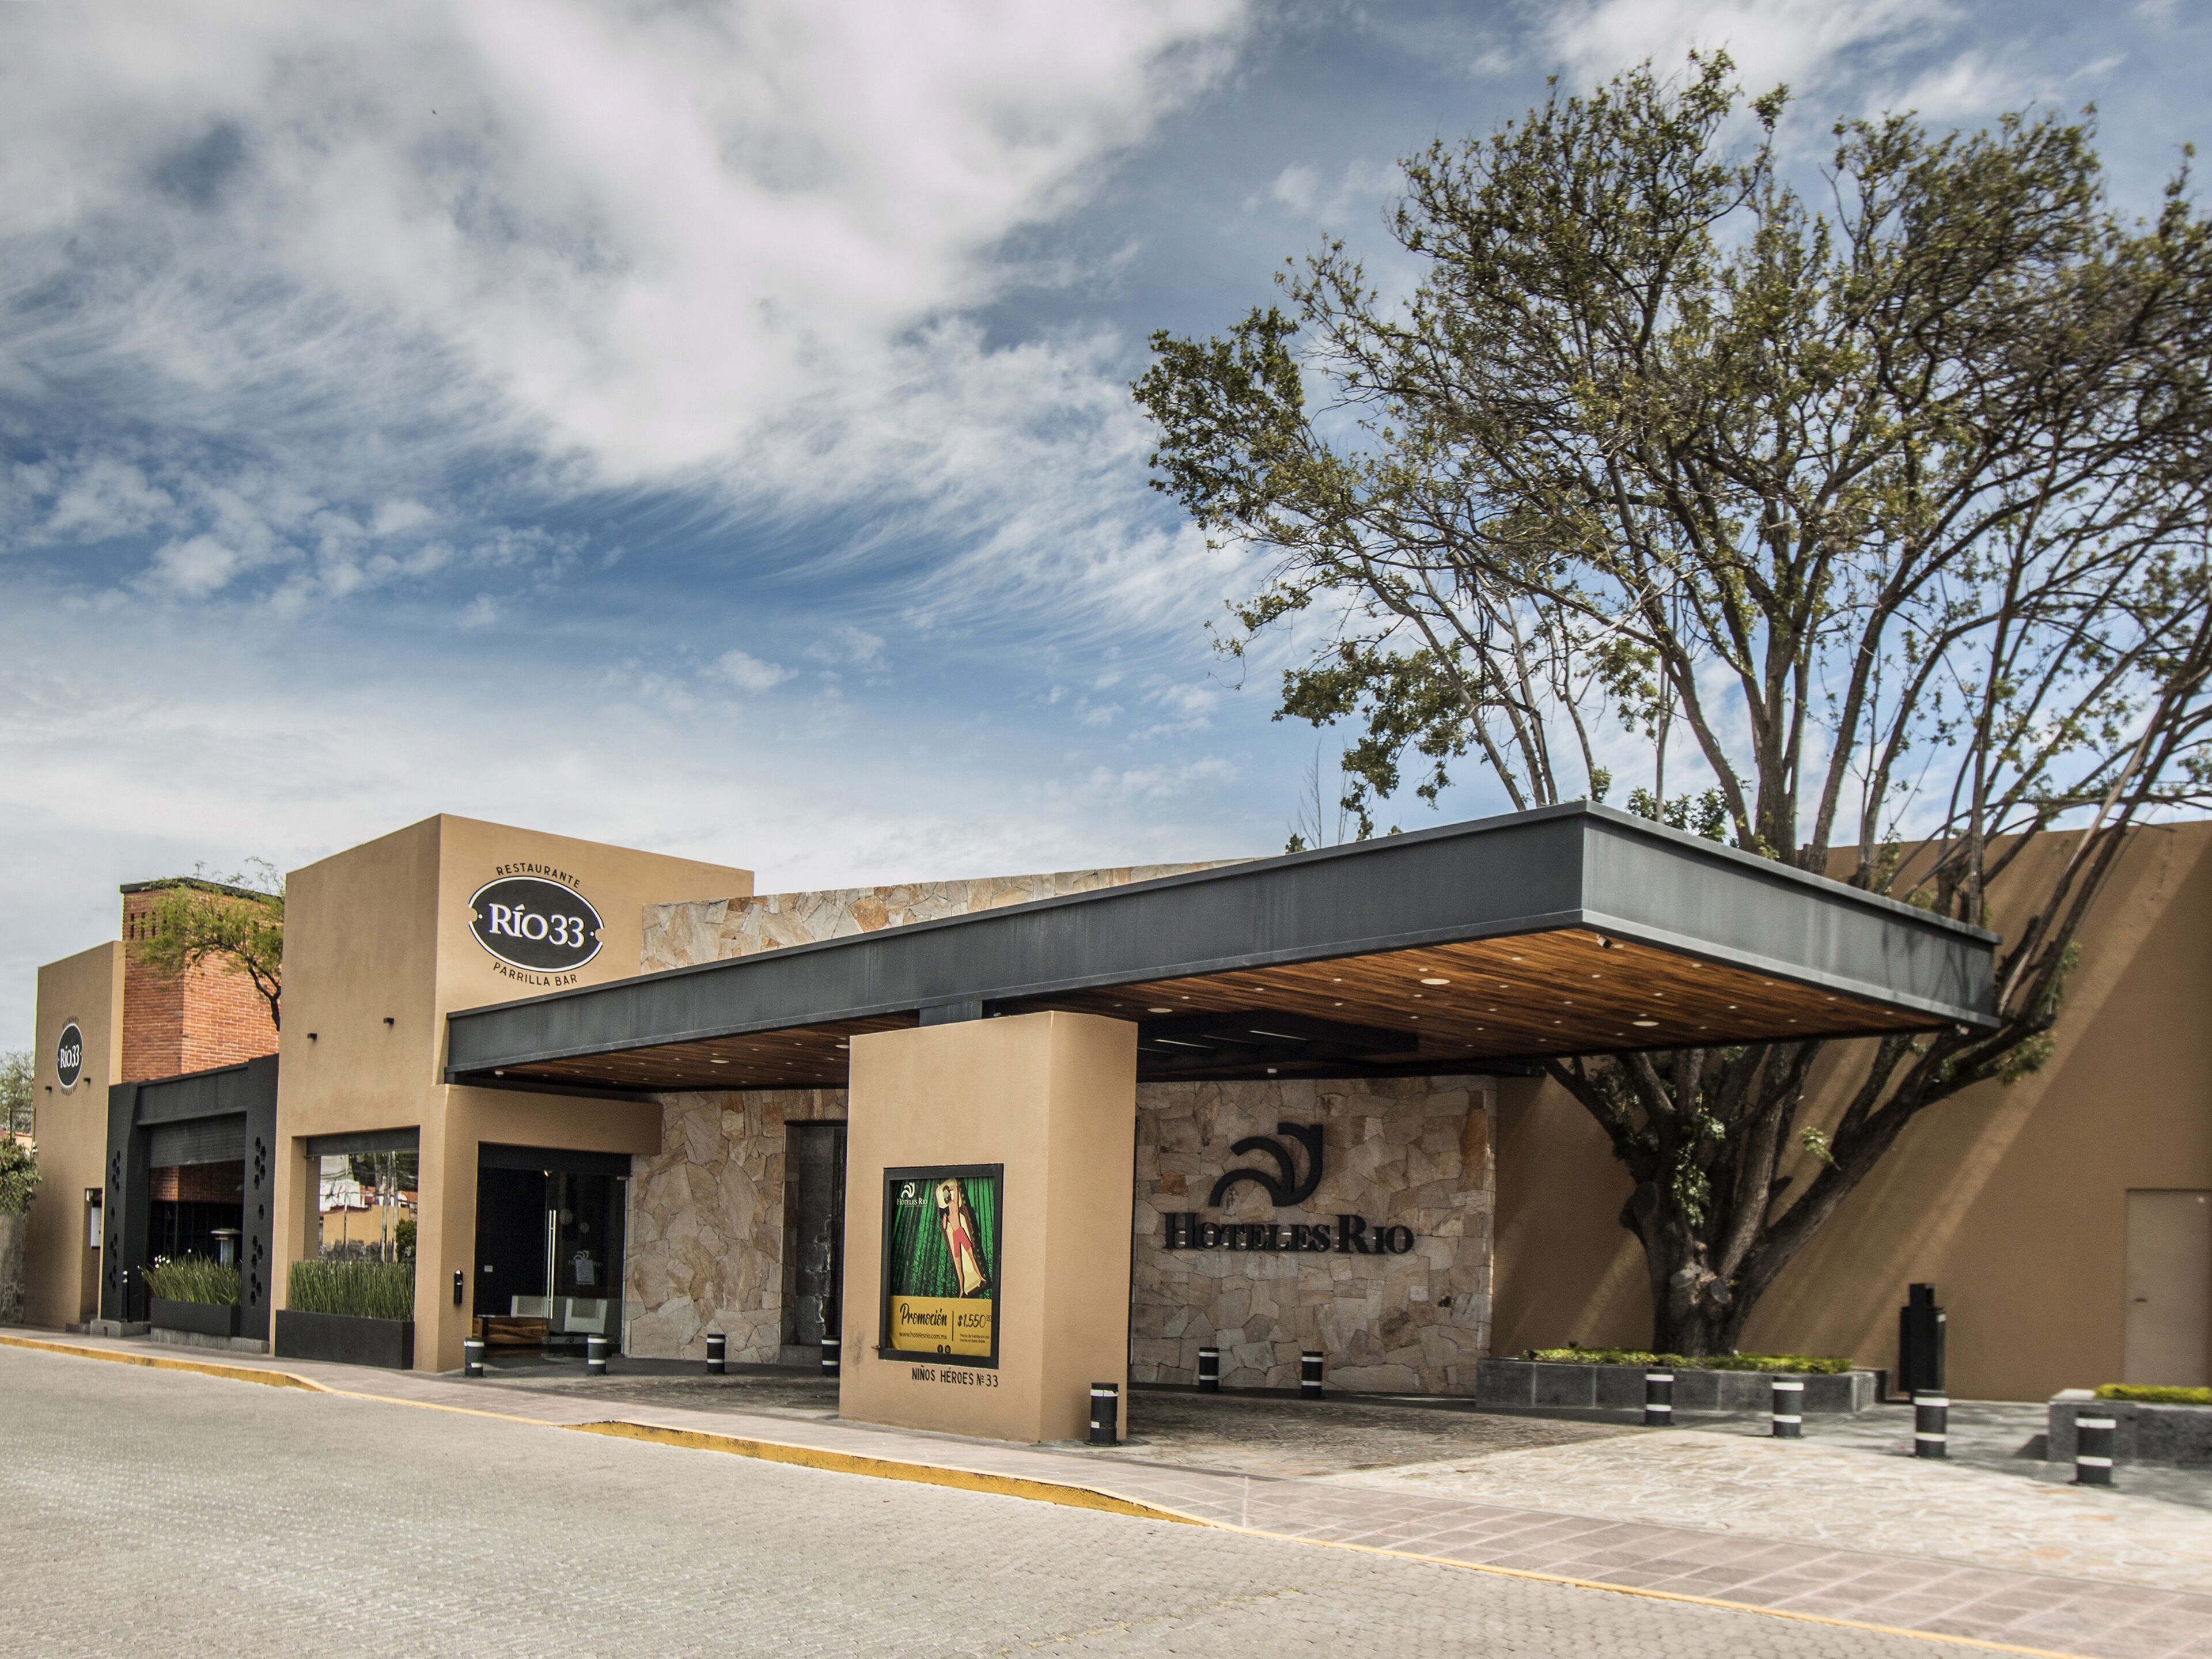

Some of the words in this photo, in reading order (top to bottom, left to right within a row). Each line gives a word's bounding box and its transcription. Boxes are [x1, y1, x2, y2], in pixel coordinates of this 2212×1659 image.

[496, 863, 580, 888] RESTAURANTE
[493, 963, 550, 986] PARRILLA
[555, 974, 577, 986] BAR
[1161, 1212, 1331, 1251] HOTELES
[900, 1303, 947, 1326] Promoción
[899, 1331, 948, 1340] www.hotelesrio.com.mx
[912, 1365, 935, 1381] NIÑOS
[940, 1367, 974, 1385] HÉROES
